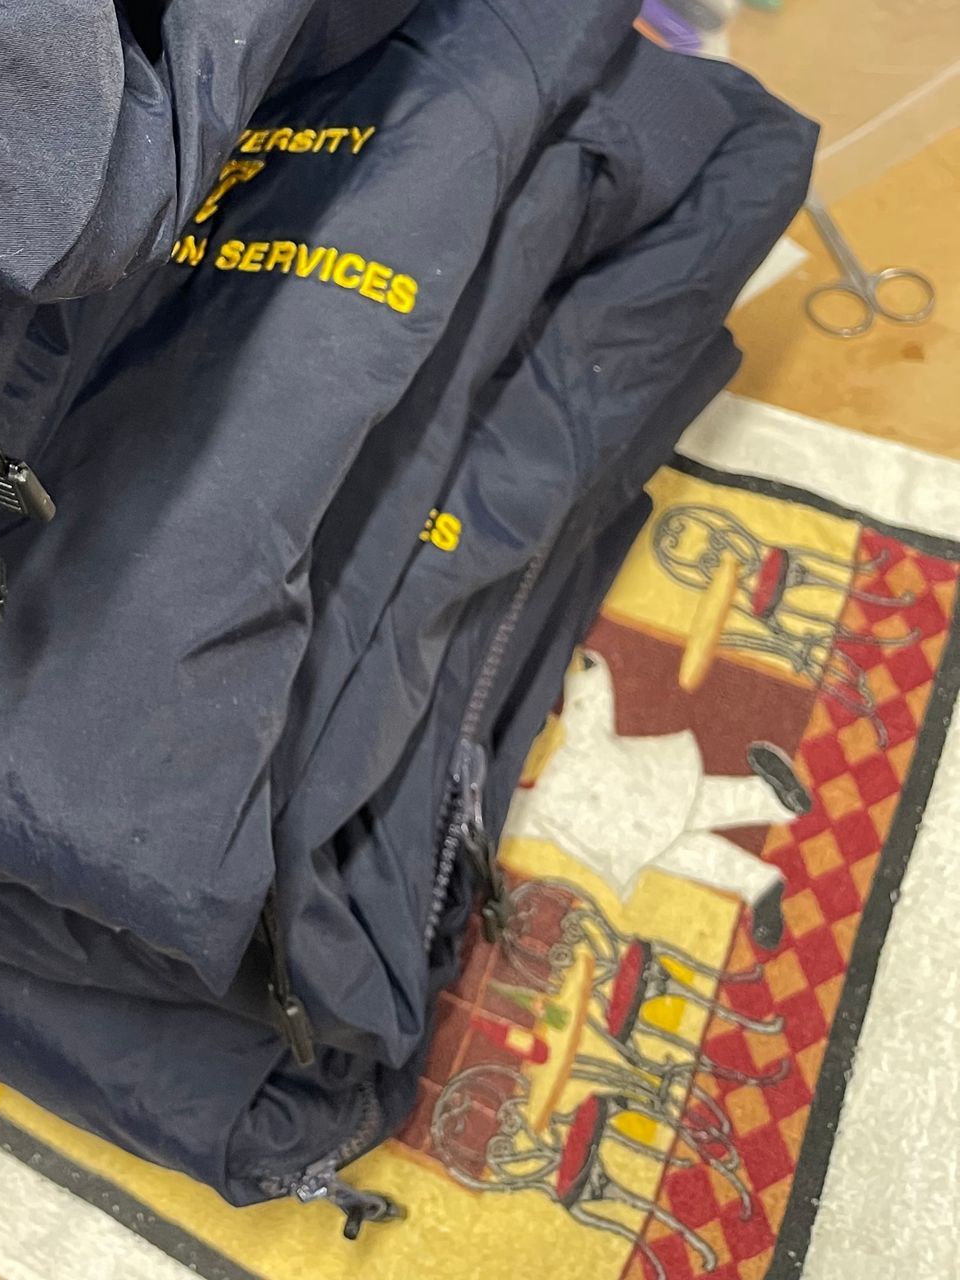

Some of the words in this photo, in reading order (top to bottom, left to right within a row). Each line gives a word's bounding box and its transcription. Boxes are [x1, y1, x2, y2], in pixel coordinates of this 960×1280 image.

[170, 234, 208, 266] N
[214, 239, 419, 315] SERVICES
[418, 508, 462, 552] S
